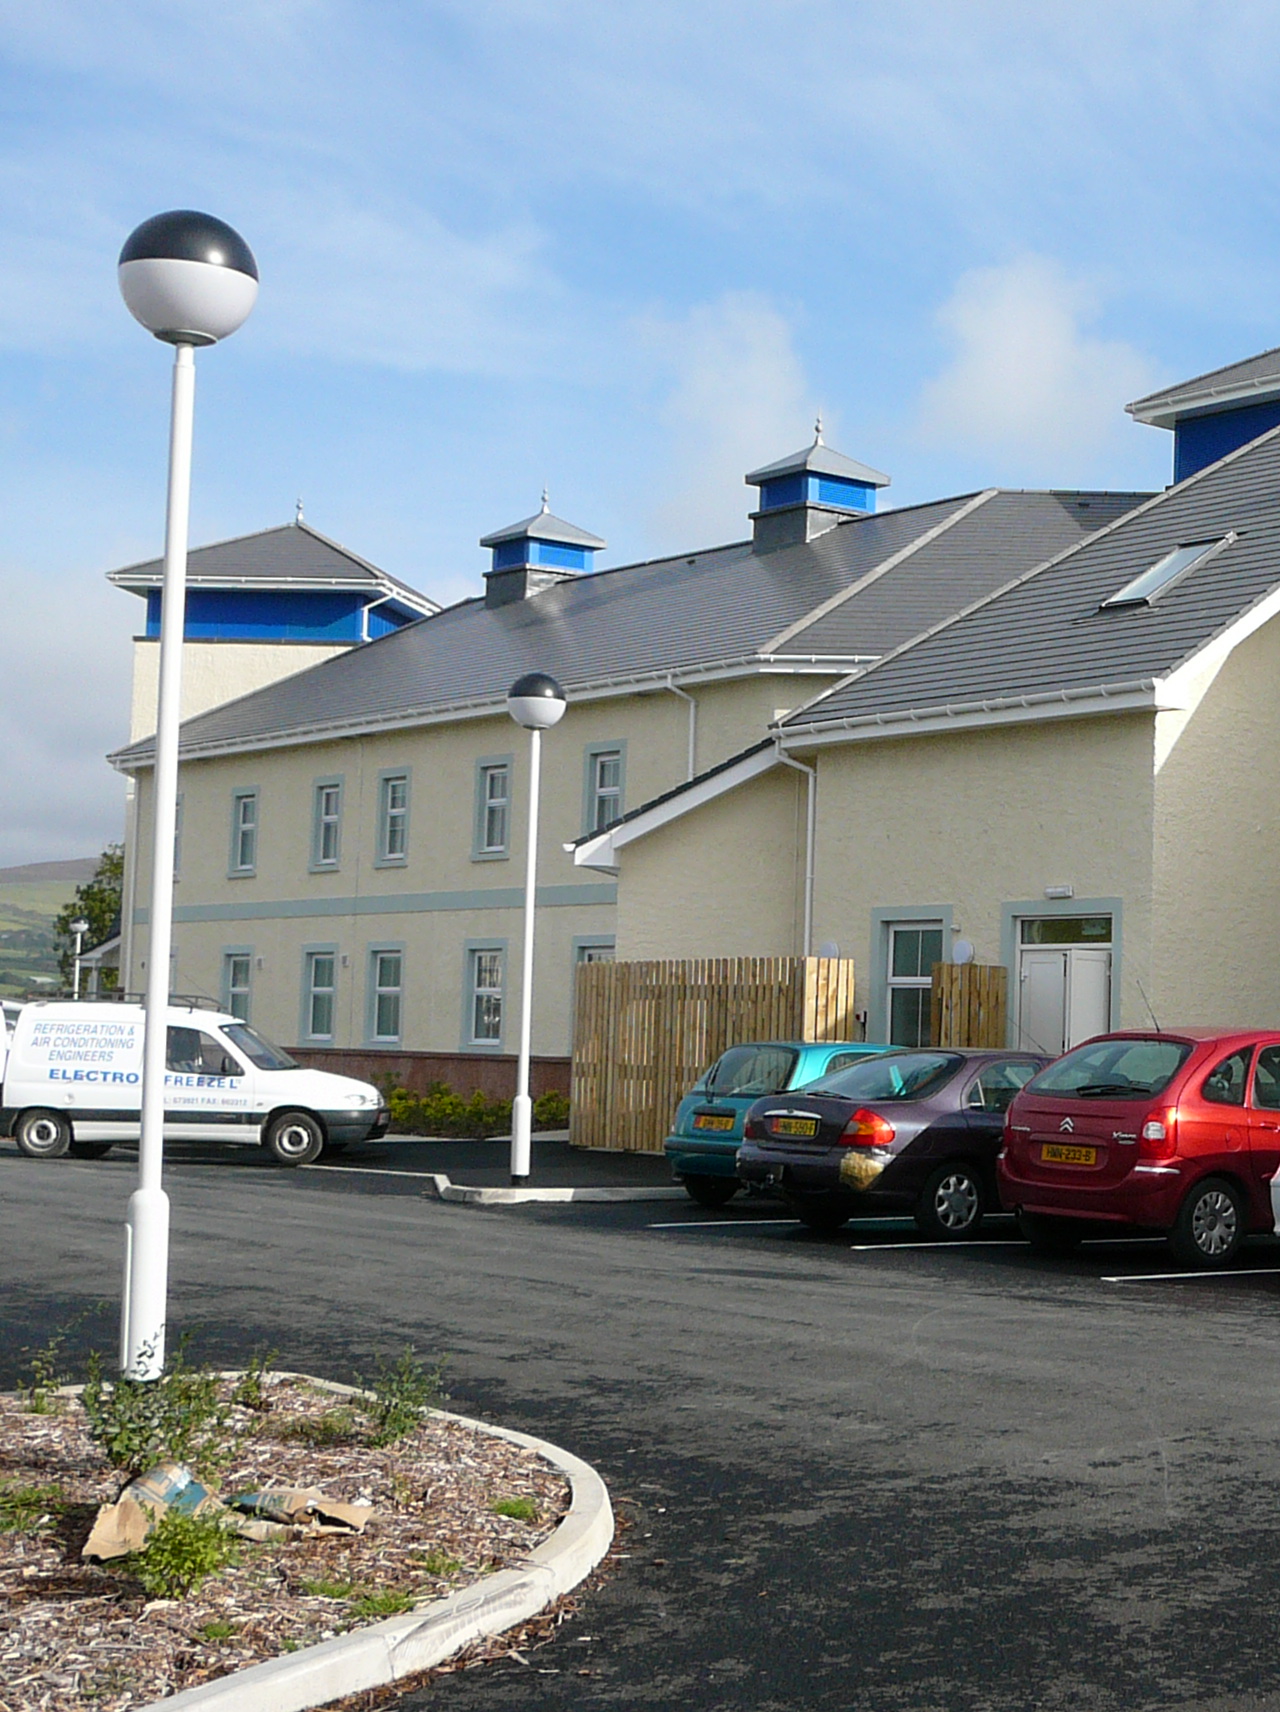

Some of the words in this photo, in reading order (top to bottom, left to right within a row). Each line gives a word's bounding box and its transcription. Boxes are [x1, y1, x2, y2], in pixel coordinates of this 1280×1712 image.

[33, 1023, 125, 1035] REFRIGERATION
[127, 1025, 135, 1036] &
[31, 1036, 51, 1047] AIR
[53, 1037, 135, 1049] CONDITIONING
[48, 1050, 114, 1061] ENGINEERS
[49, 1068, 140, 1084] ELECTRO
[164, 1075, 226, 1088] FREEZE
